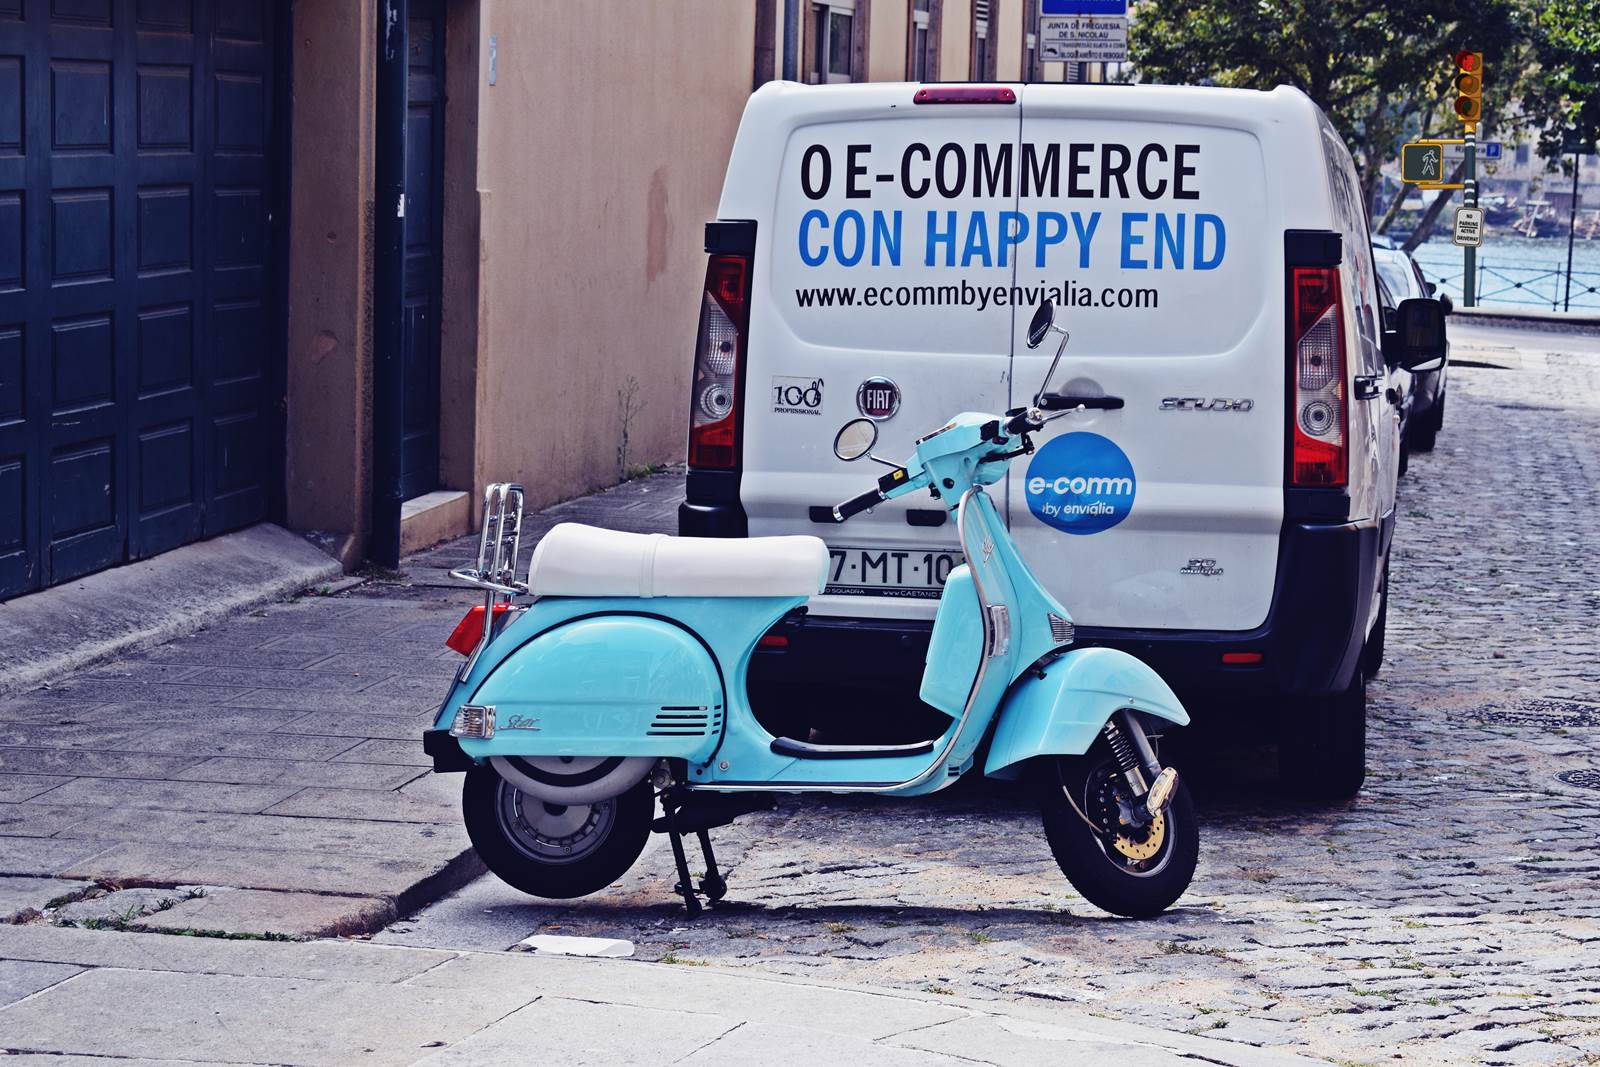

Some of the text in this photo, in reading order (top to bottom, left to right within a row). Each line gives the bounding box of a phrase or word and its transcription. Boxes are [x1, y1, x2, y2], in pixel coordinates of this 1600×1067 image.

[1047, 22, 1121, 30] JUNTA DE FREGUESIA
[1058, 31, 1069, 39] DE
[1077, 31, 1109, 39] NICOLAU
[801, 142, 1201, 200] O E-COMMERCE
[799, 209, 1226, 270] CON HAPPY END
[796, 279, 1158, 311] www.ecommbyenvialia.com
[866, 389, 892, 410] FIAT
[1028, 476, 1133, 496] e-comm
